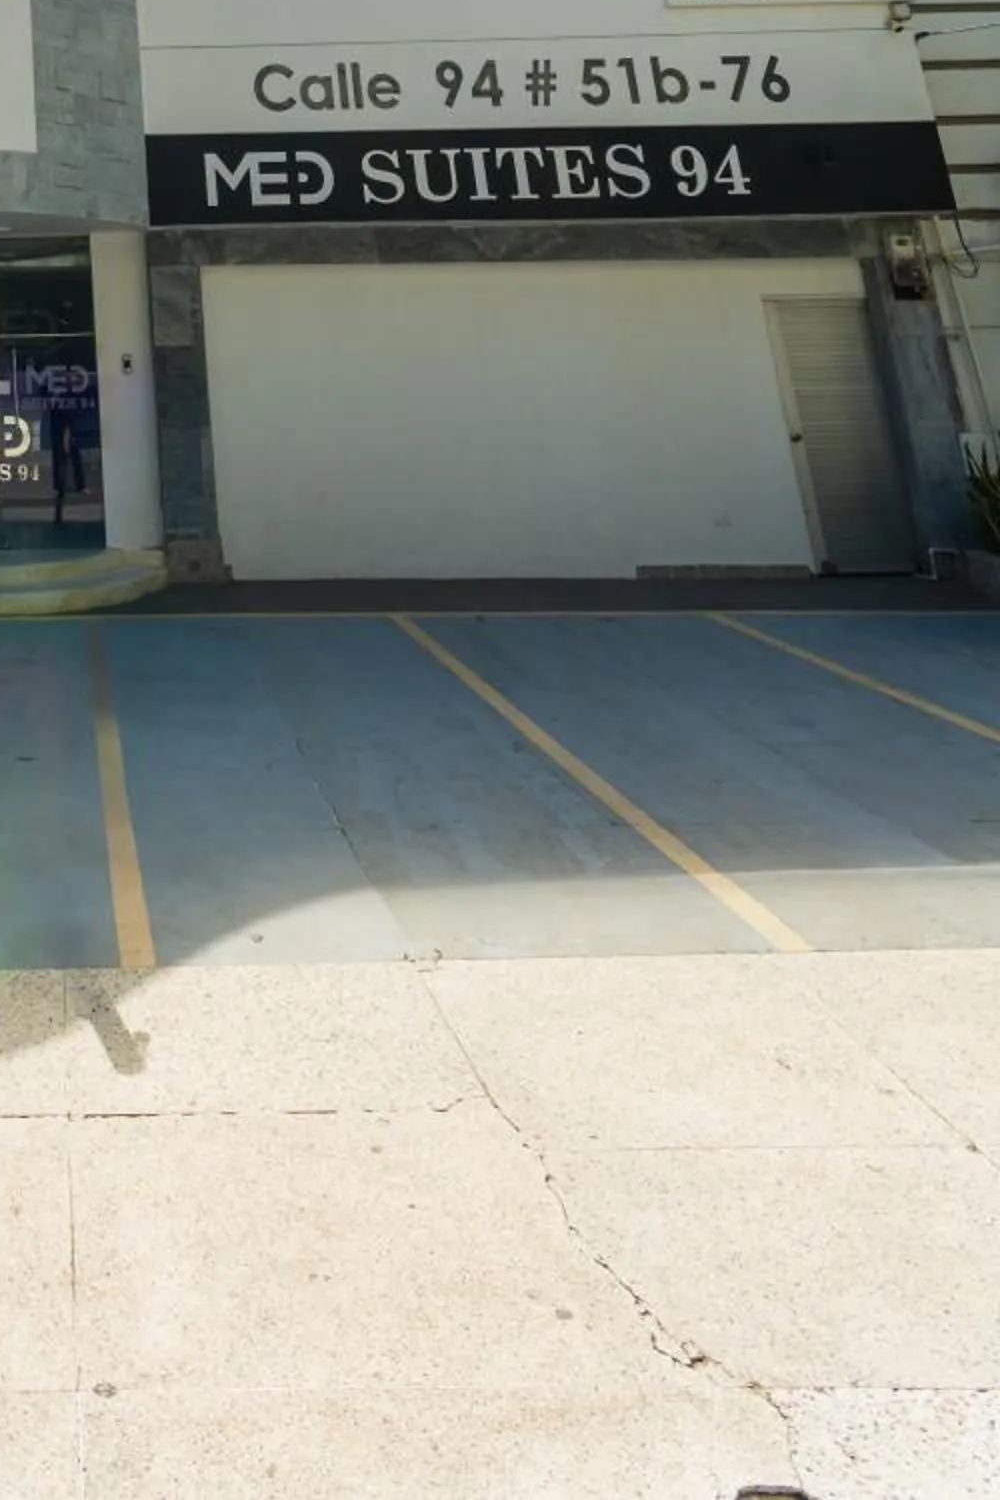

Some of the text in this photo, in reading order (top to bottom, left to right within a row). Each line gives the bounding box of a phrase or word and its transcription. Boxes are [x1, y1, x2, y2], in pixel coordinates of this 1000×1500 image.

[253, 55, 791, 112] Calle 94 # 51b-76
[204, 143, 751, 207] MED SUITES 94
